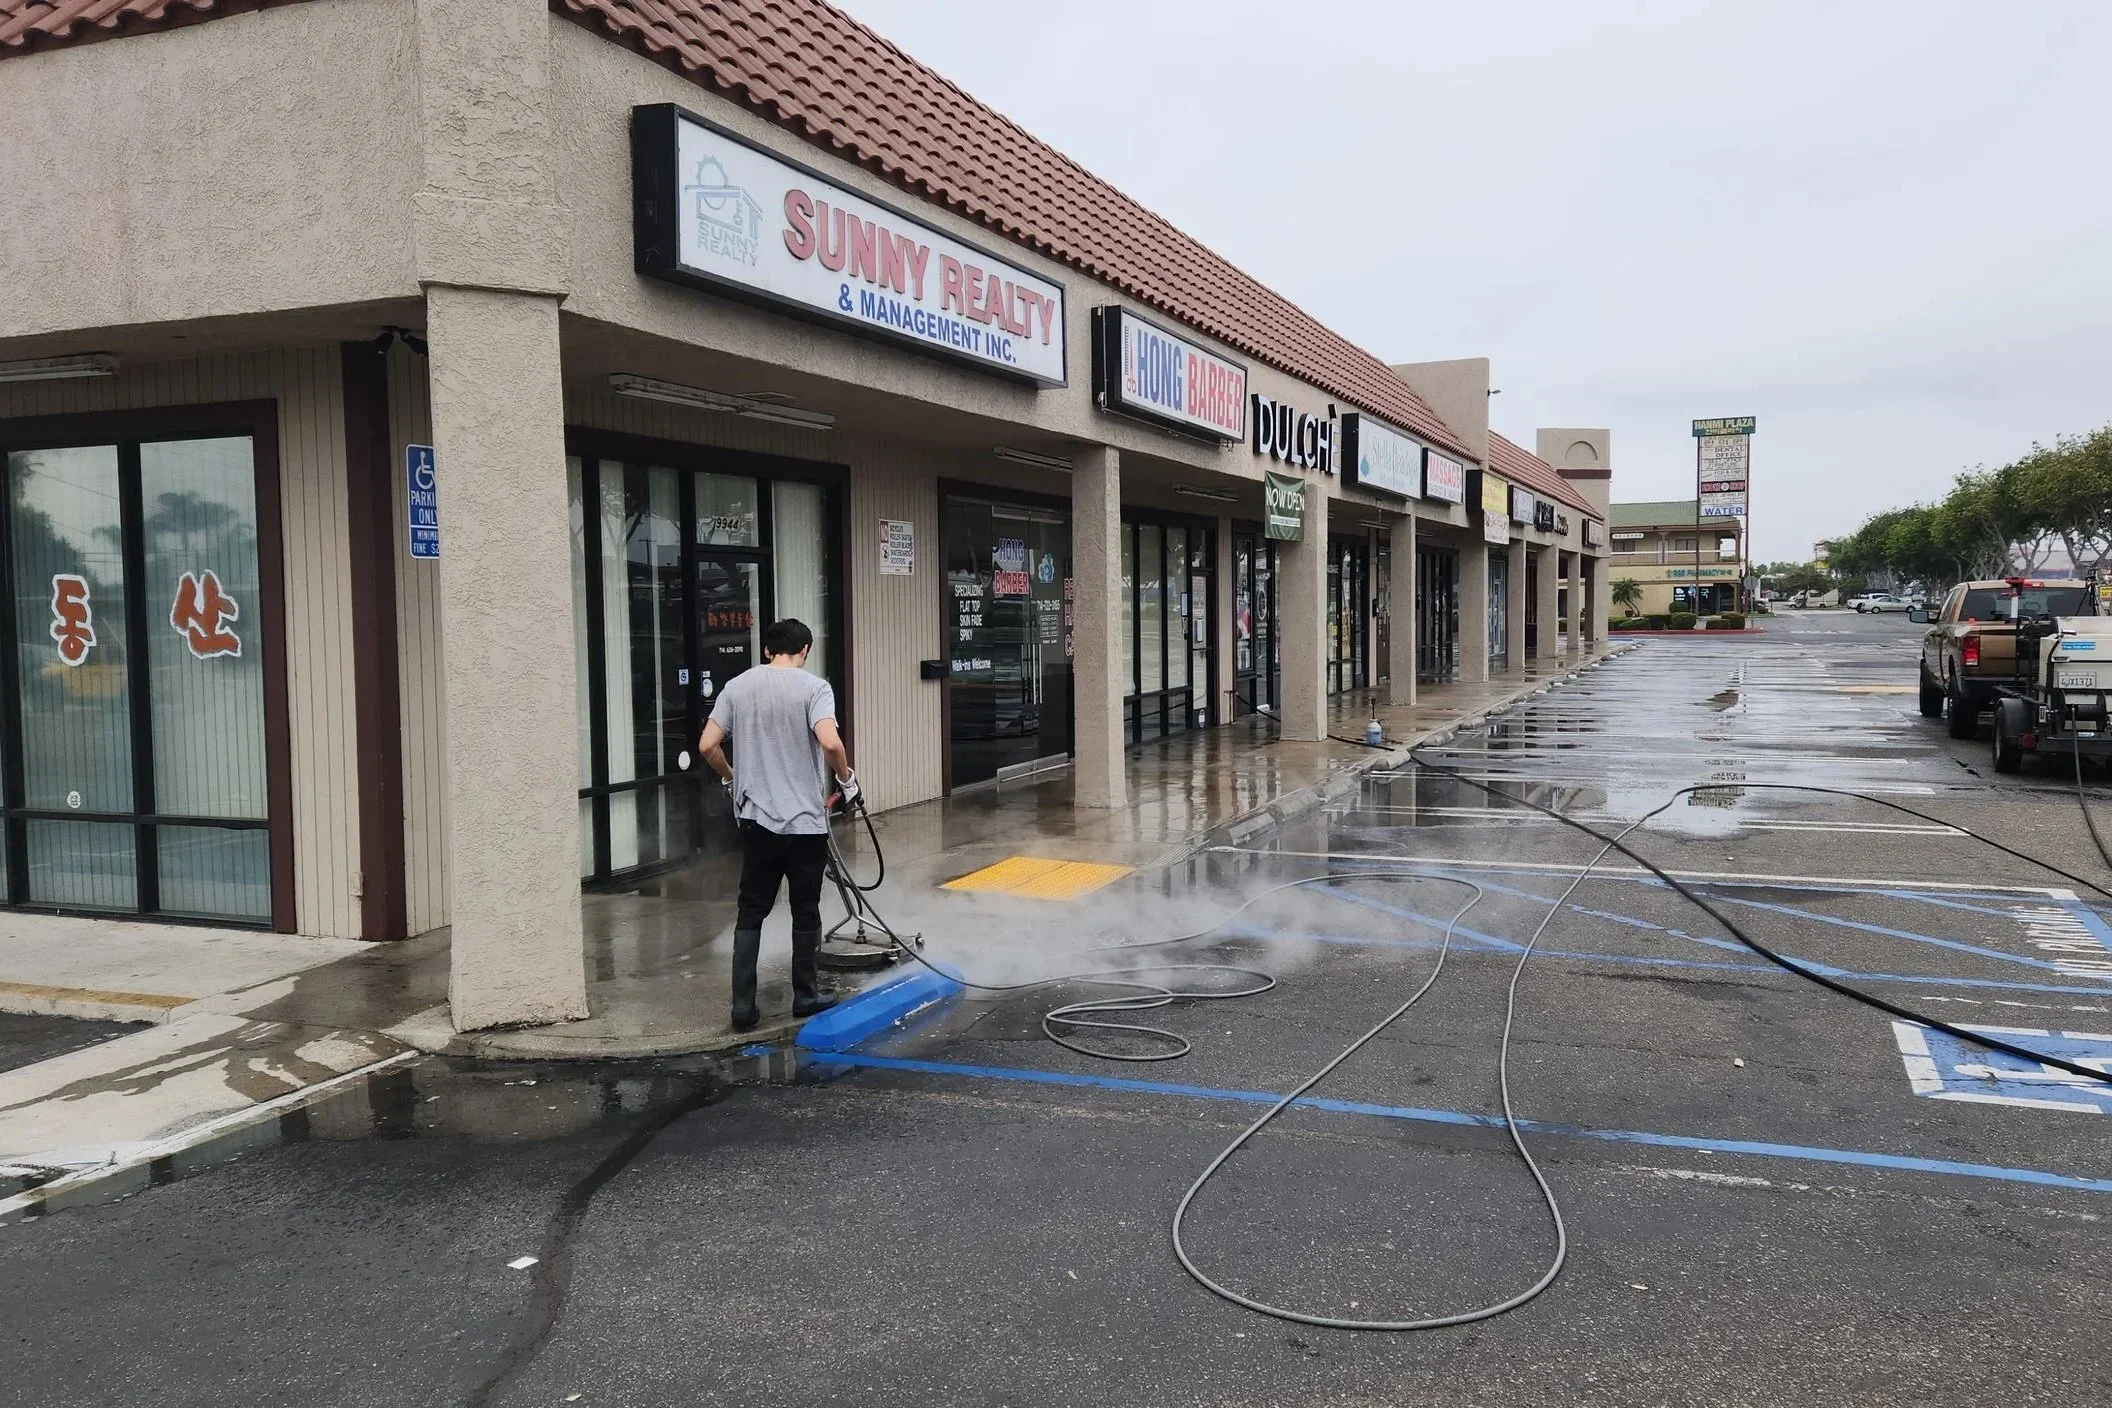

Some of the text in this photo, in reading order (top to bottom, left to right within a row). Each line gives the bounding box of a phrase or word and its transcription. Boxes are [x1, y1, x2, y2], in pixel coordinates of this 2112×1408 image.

[698, 220, 759, 254] SUNNY
[697, 236, 759, 266] REALTY
[783, 189, 1055, 345] SUNNY REALTY
[838, 284, 1017, 364] & MANAGEMENT INC.
[1137, 329, 1243, 432] HONG BARBER
[1694, 417, 1754, 430] HANMI PLAZA
[1429, 455, 1461, 489] MASSAGE
[411, 491, 436, 506] PARKI
[1265, 486, 1305, 511] NOW OPEN
[1704, 507, 1743, 515] WATER
[716, 517, 739, 530] 9944
[417, 530, 439, 541] MINIM
[413, 543, 427, 554] FINE
[1000, 537, 1024, 563] HONG
[994, 569, 1029, 595] BARBER
[955, 584, 984, 597] SPECIALIZING
[960, 600, 981, 613] FLAT TOP
[960, 614, 983, 627] SKIN FADE
[960, 628, 973, 641] SPIKY
[952, 658, 991, 672] Walk-ins Welcome
